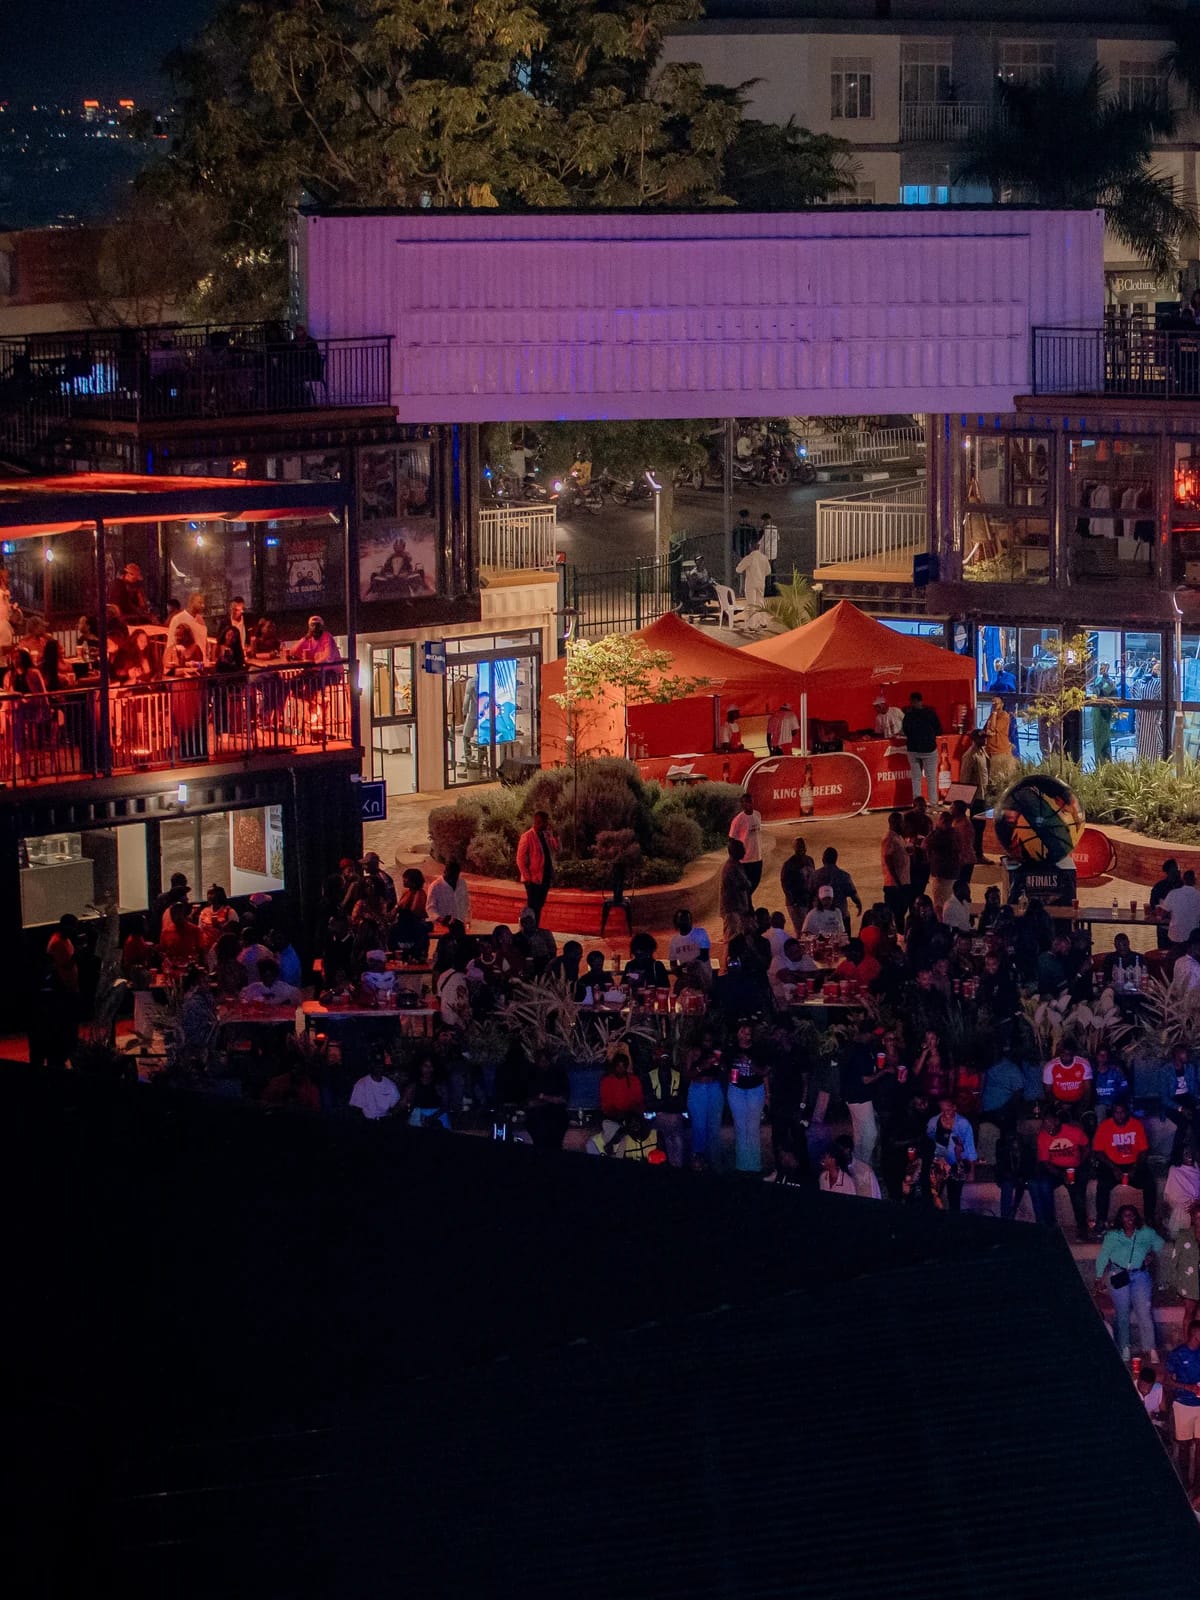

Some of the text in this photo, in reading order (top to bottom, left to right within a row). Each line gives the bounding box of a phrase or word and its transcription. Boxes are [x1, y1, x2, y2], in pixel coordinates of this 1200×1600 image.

[1124, 279, 1156, 294] Clothing
[773, 789, 796, 800] KING
[812, 784, 842, 797] BEERS
[1112, 1132, 1136, 1146] JUST
